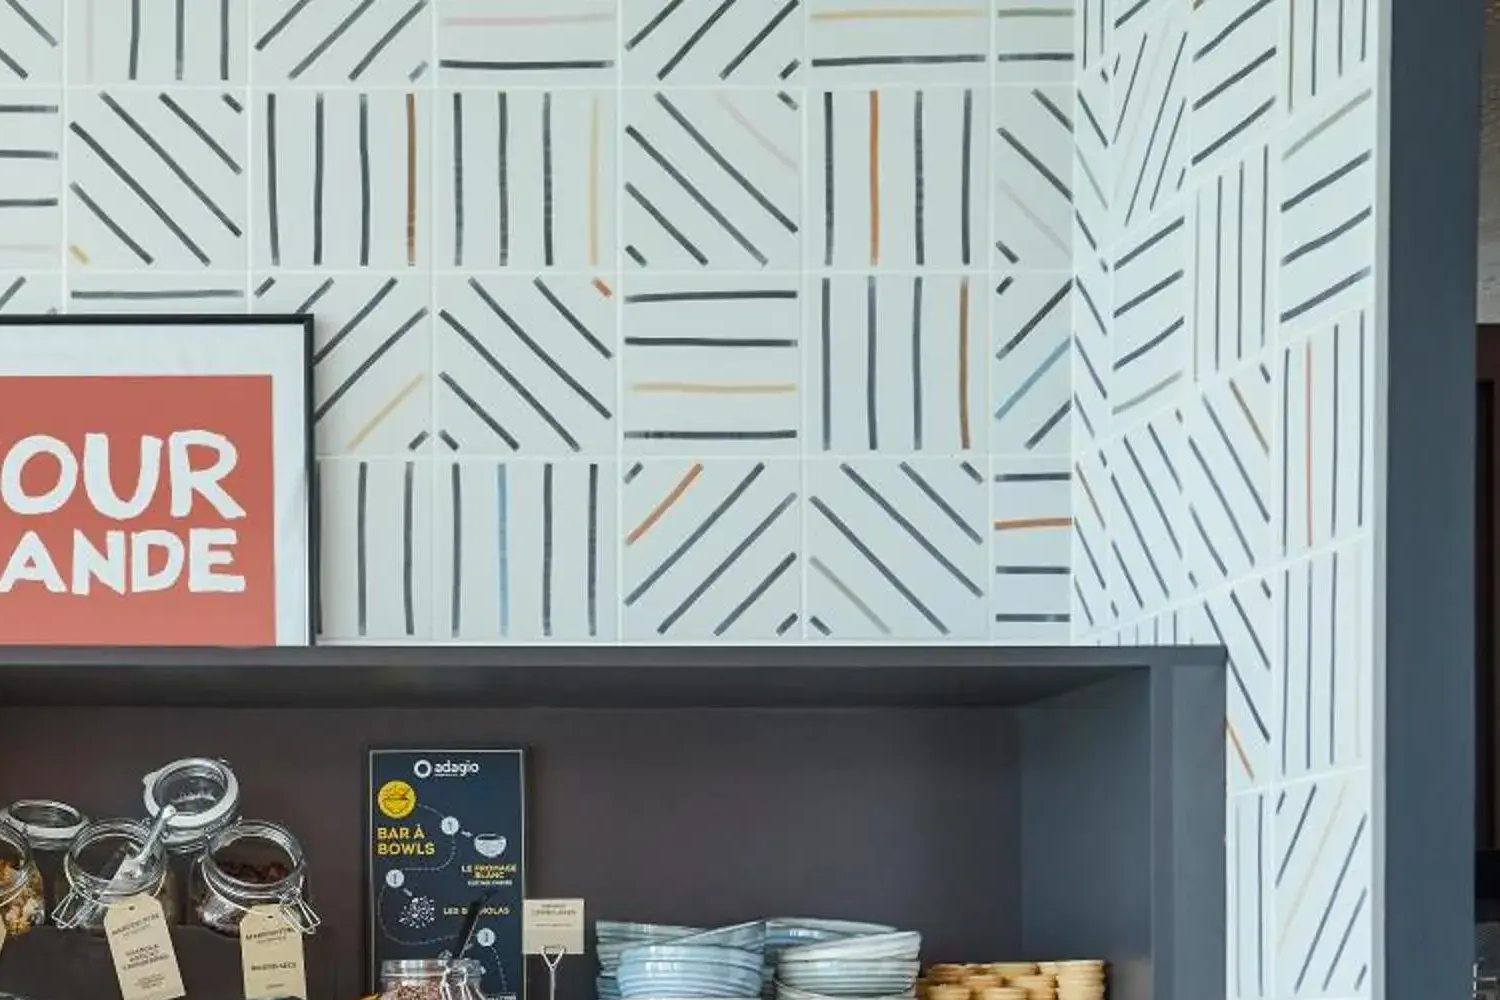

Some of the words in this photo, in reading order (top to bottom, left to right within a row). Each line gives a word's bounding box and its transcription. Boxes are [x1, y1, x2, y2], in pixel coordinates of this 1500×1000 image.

[434, 759, 479, 777] adagio
[377, 827, 410, 839] BAR
[377, 843, 435, 855] BOWLS
